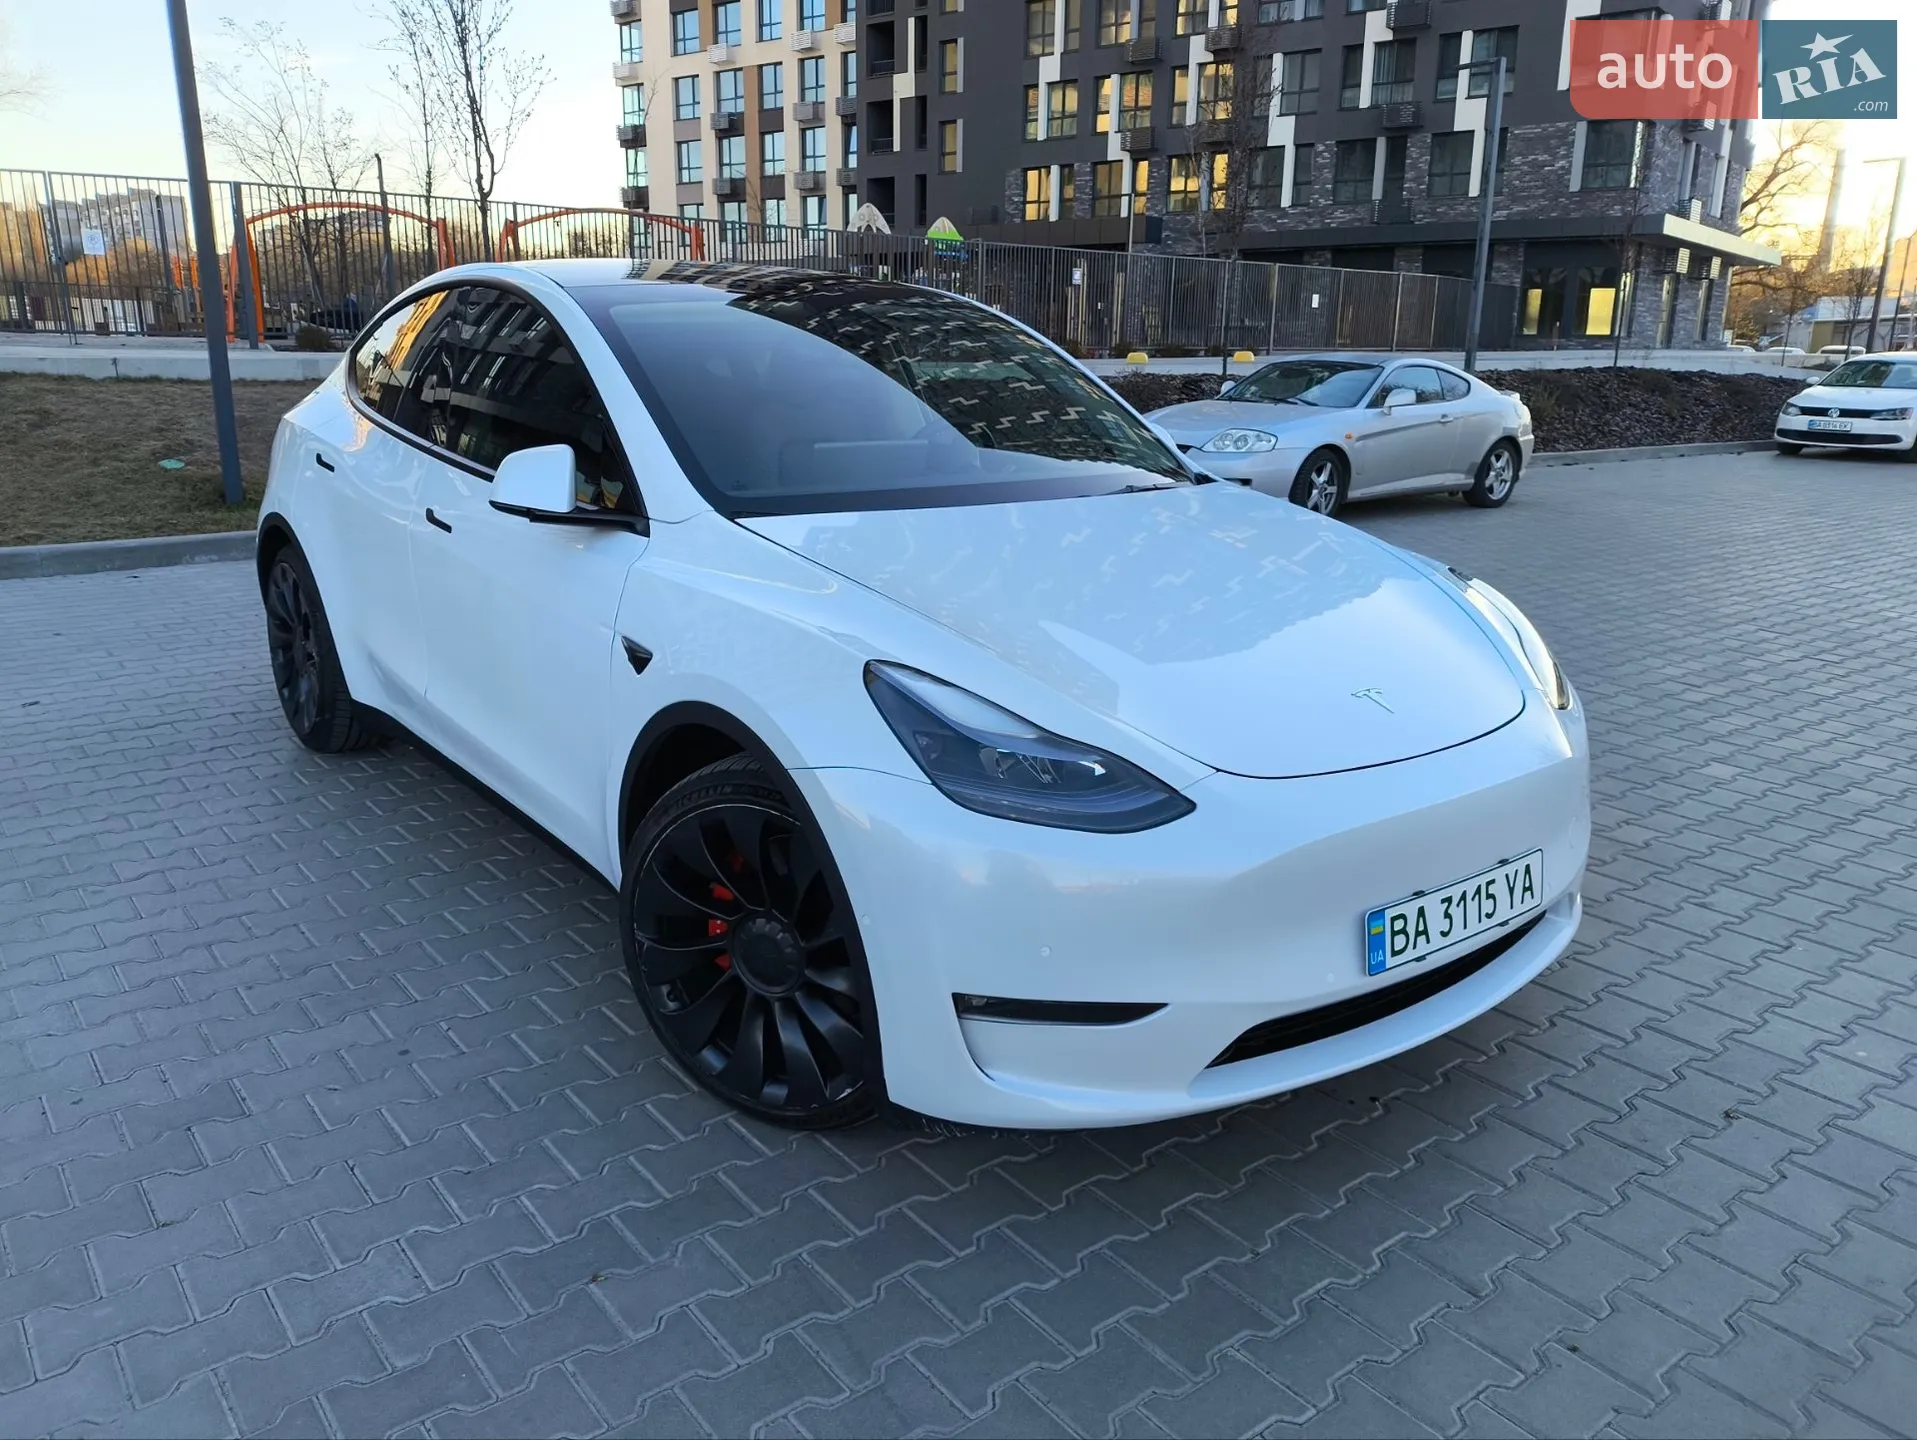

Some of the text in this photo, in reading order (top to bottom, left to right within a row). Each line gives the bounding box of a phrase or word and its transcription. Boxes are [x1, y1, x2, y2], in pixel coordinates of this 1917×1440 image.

[1390, 863, 1535, 958] BA 3115 YA
[1370, 949, 1385, 965] UA
